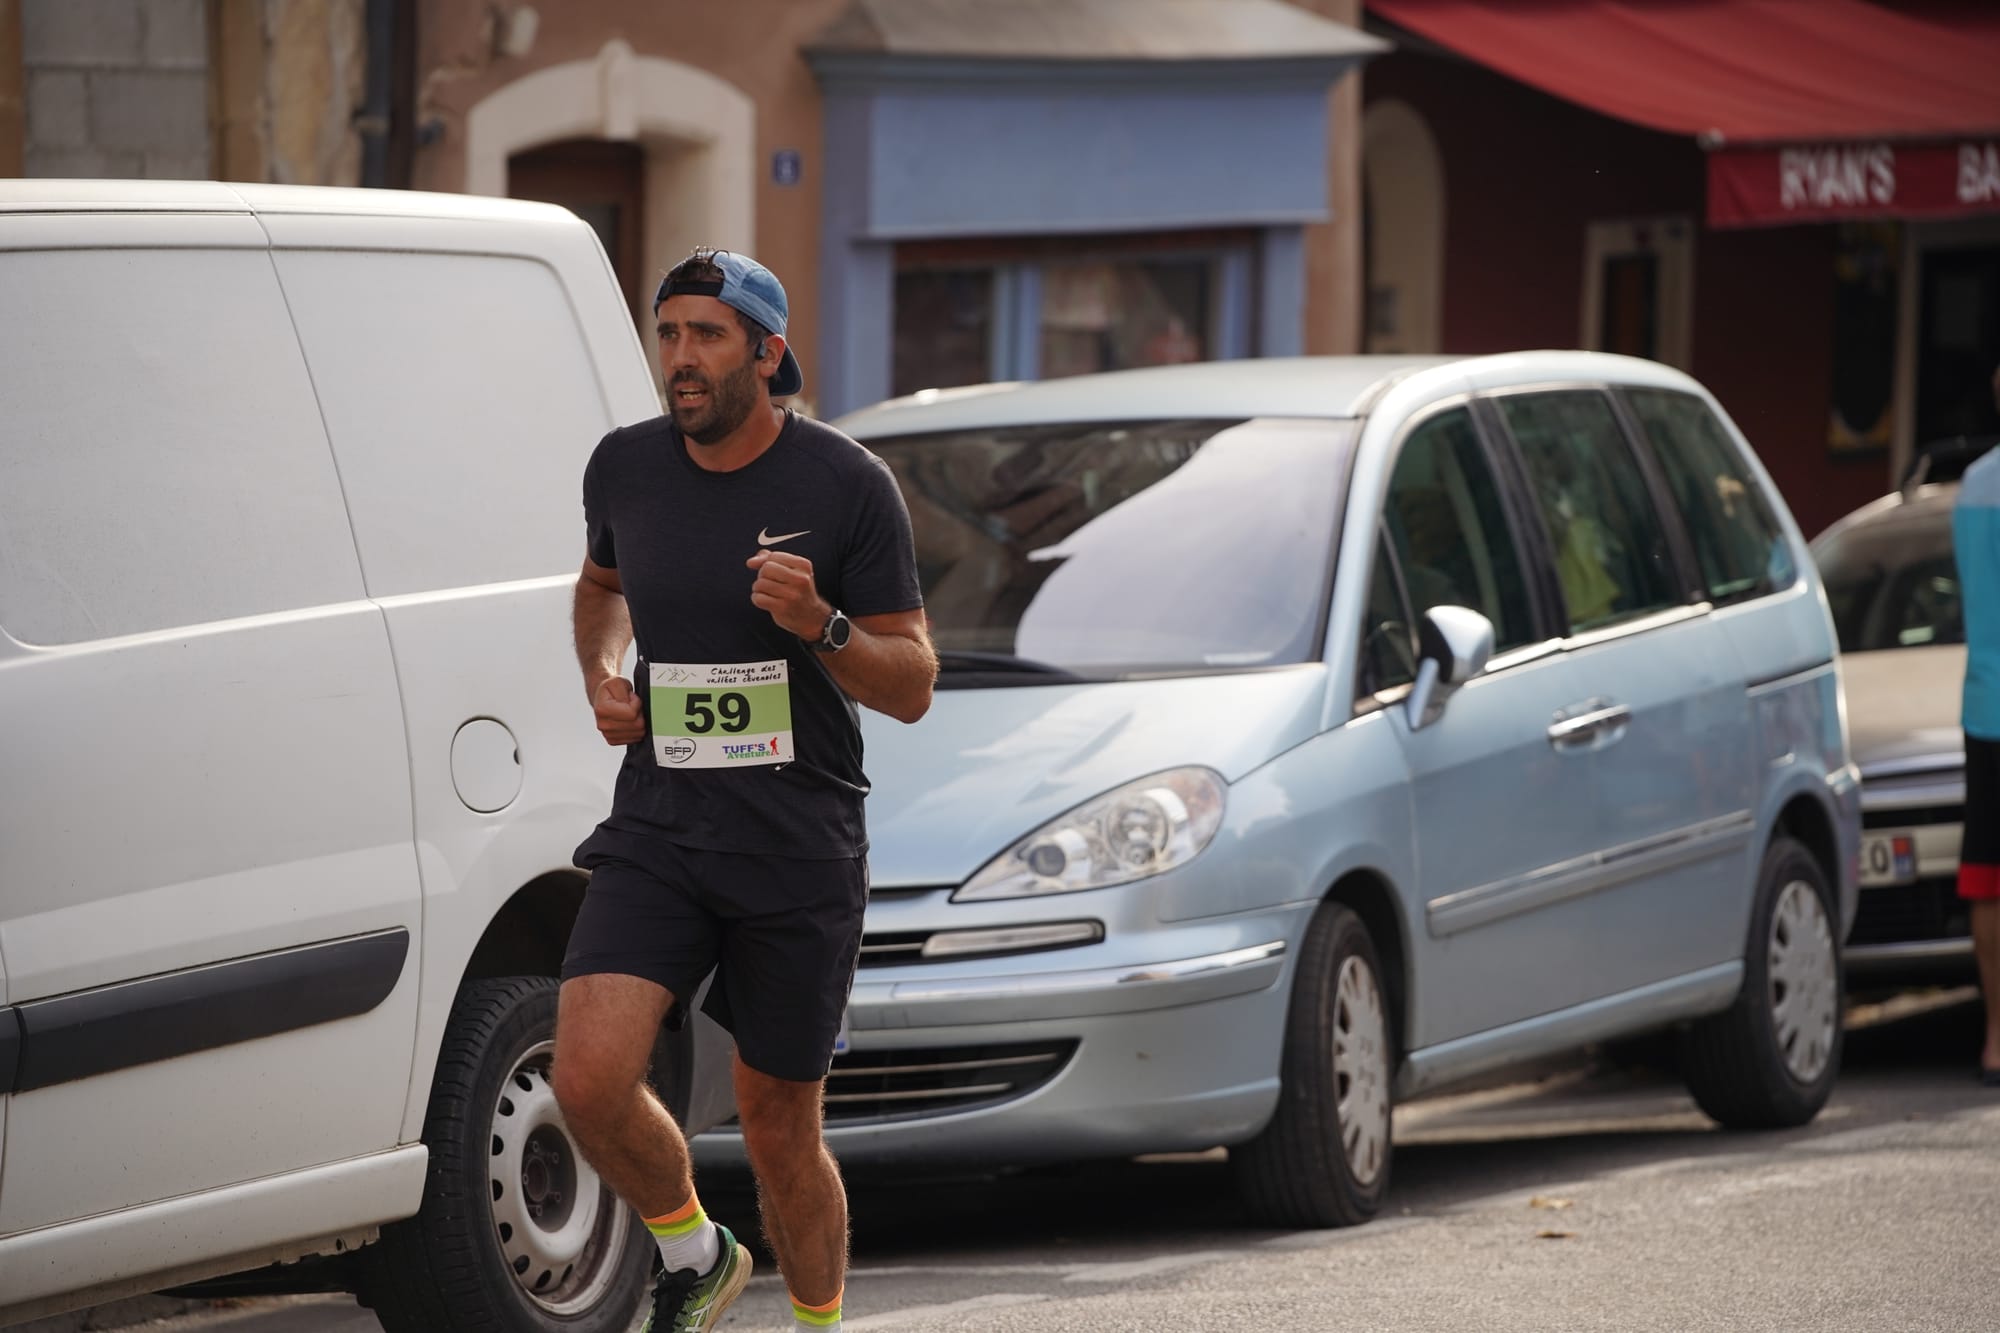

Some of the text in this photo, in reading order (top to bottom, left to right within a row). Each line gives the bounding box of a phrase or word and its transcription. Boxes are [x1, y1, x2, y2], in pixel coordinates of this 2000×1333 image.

[1779, 145, 1896, 209] RYAN'S
[711, 667, 755, 677] Challenge
[707, 673, 781, 684] vallées cévenoles
[684, 692, 751, 734] 59
[664, 746, 692, 756] BFP
[722, 743, 766, 754] TUFF'S
[727, 750, 771, 760] Aventure
